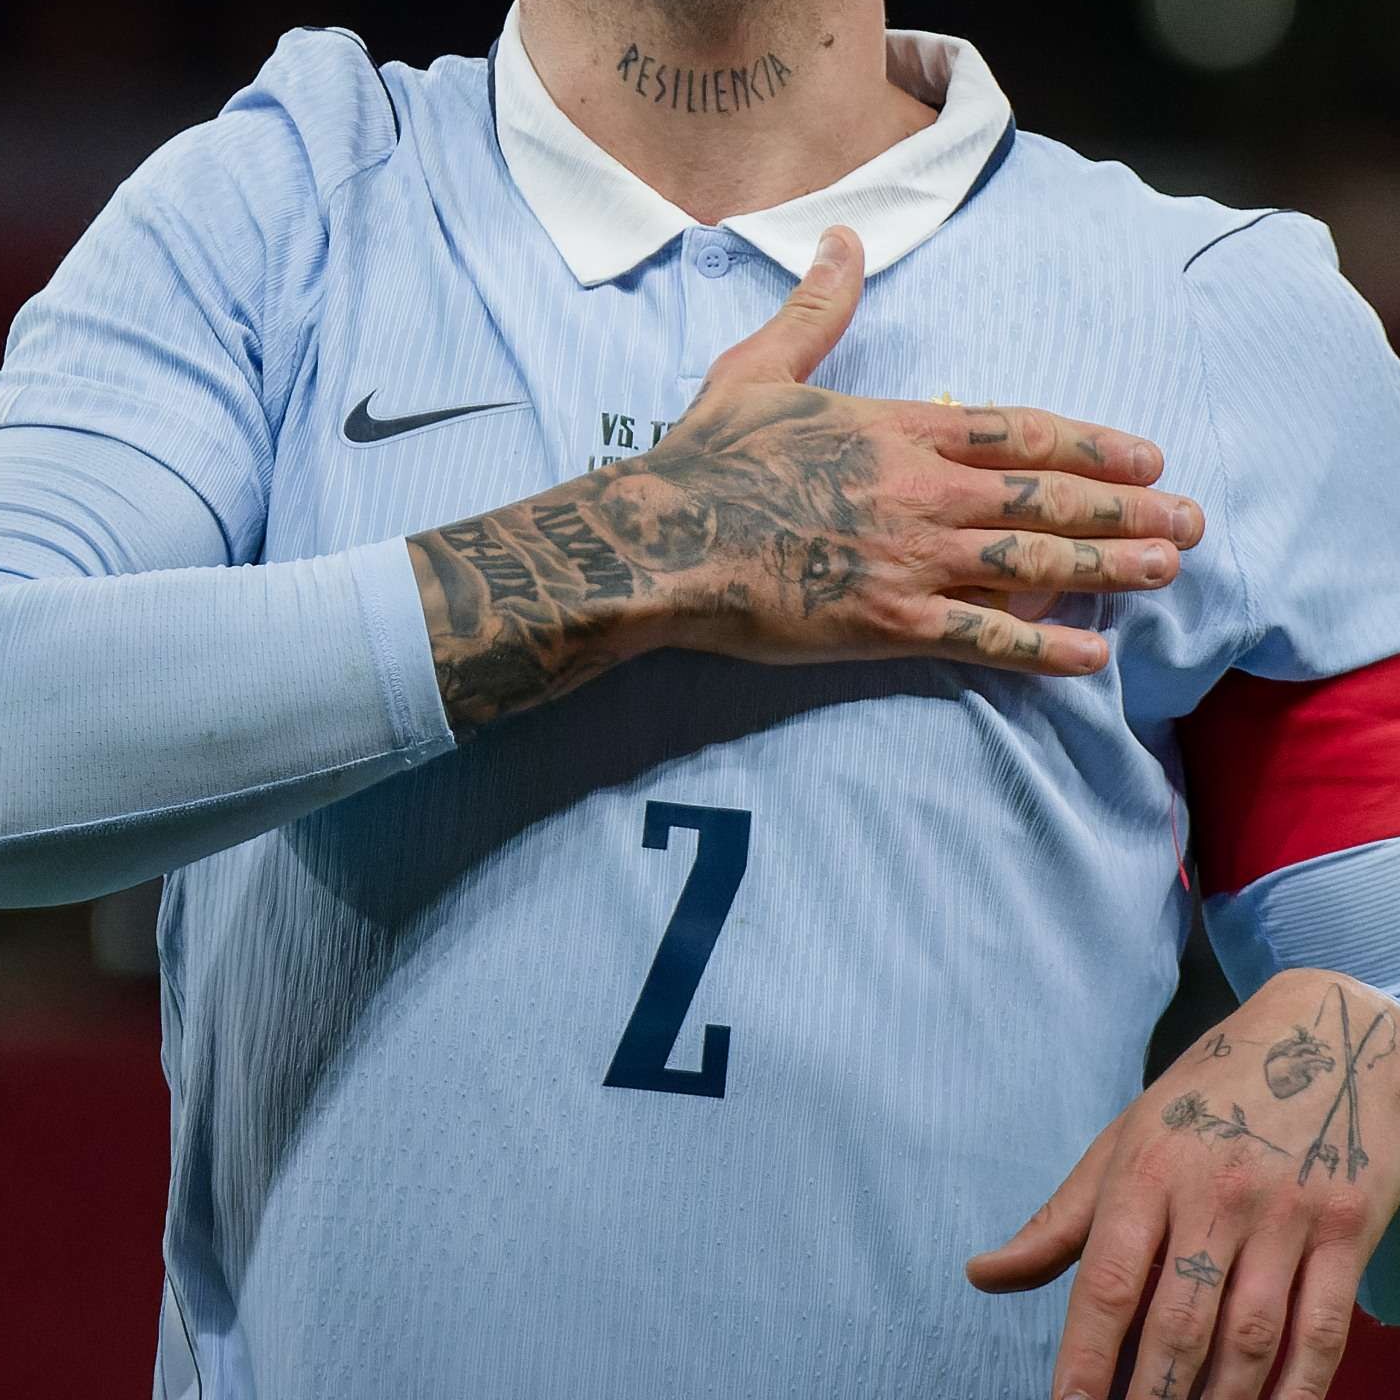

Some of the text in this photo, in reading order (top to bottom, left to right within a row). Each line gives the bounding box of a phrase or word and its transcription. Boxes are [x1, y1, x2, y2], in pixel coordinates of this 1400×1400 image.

[616, 42, 792, 114] RESILIENCIA
[601, 412, 639, 450] VS.
[602, 800, 752, 1099] 2
